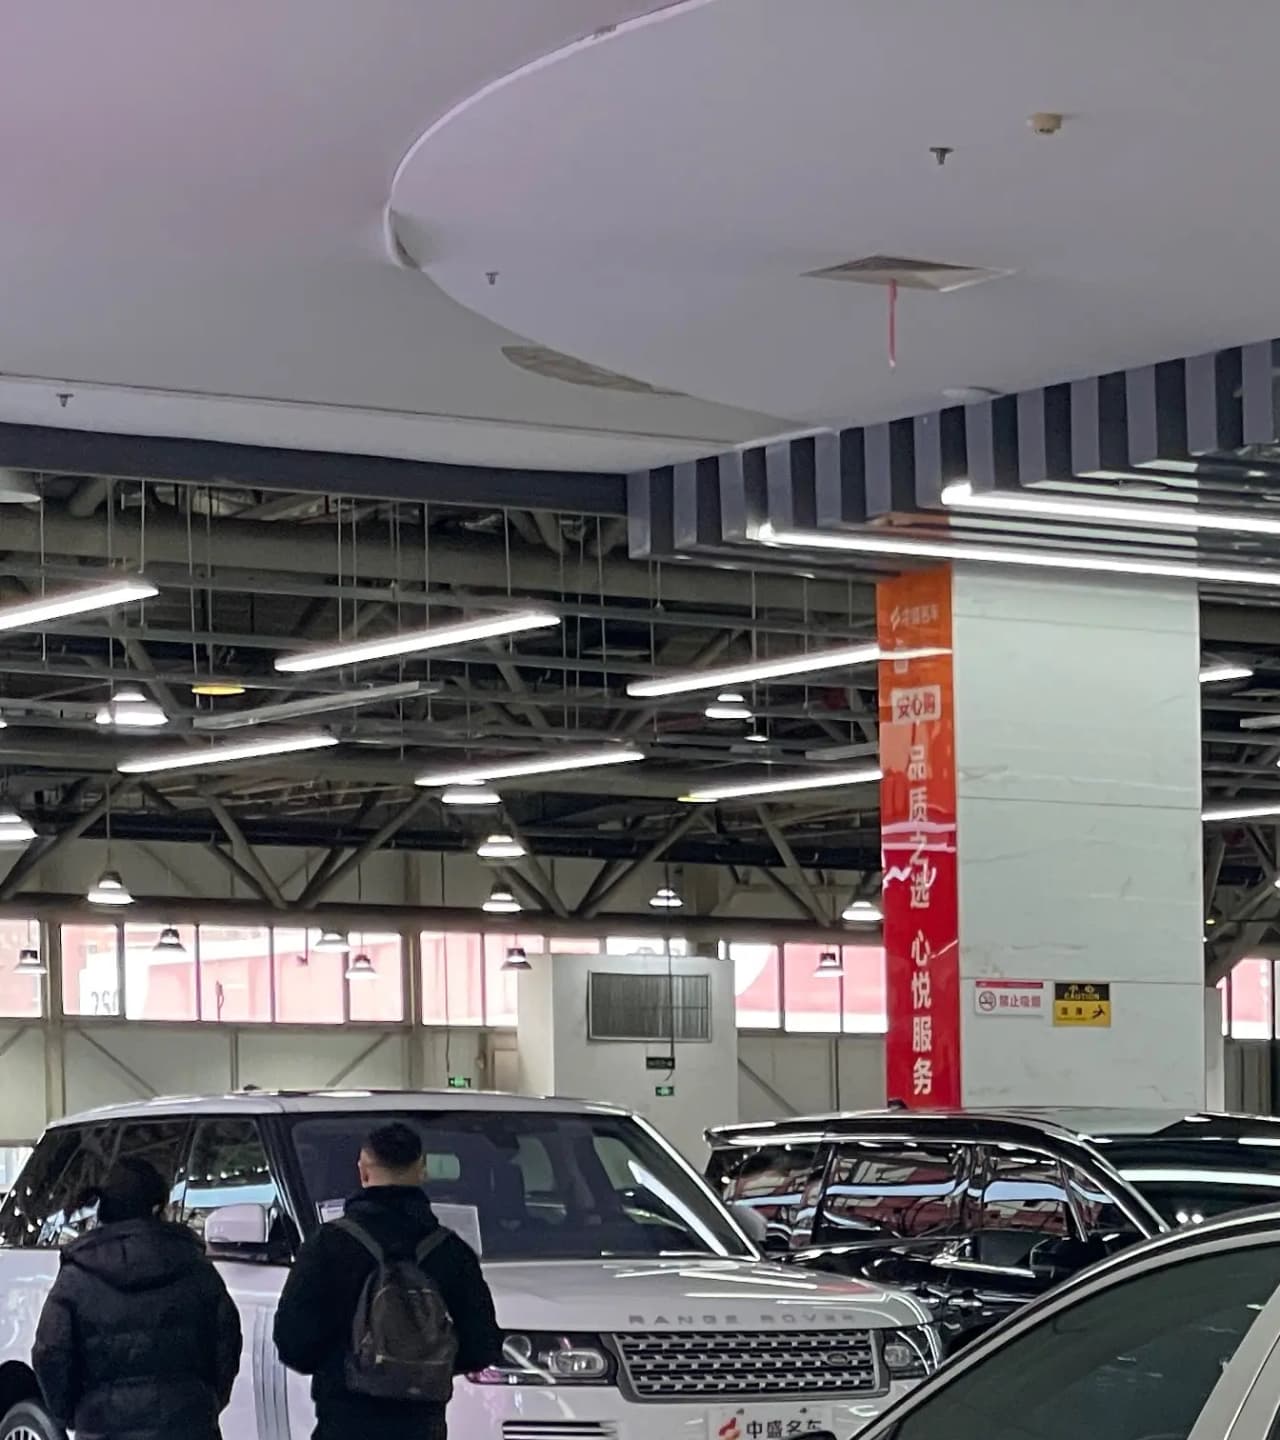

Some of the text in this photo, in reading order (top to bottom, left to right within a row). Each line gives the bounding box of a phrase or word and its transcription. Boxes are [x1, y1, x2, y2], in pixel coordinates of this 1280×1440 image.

[907, 746, 934, 1096] 品质之选 心悦服务
[628, 1314, 855, 1325] RANGE ROVER
